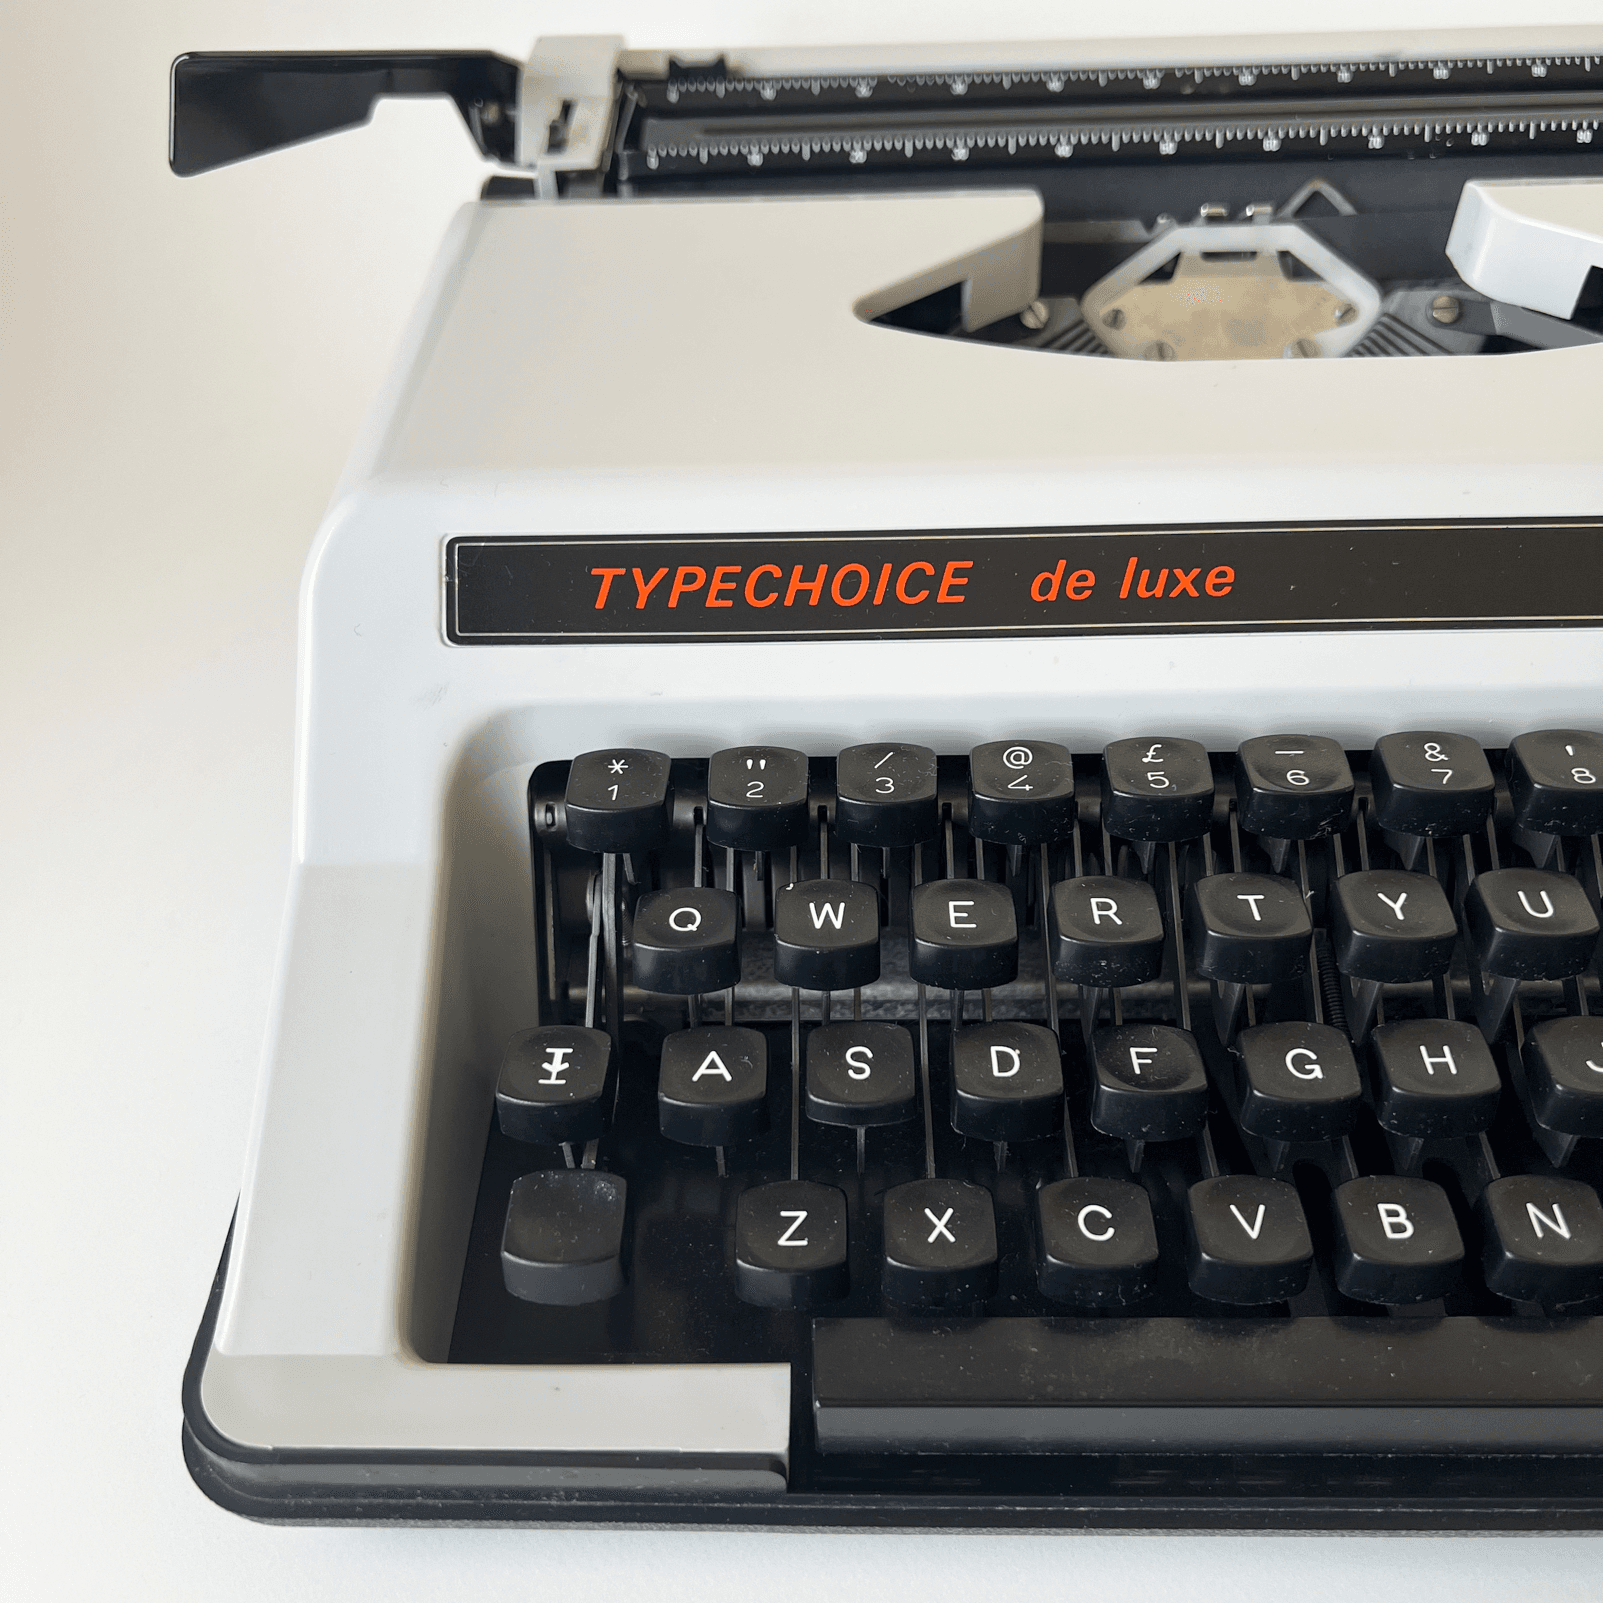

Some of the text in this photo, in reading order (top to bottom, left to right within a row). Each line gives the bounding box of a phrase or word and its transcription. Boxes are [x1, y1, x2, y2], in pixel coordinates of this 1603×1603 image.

[590, 556, 1235, 609] TYPECHOICE de luxe
[873, 751, 894, 769] /
[1002, 745, 1033, 770] @
[1141, 743, 1164, 763] £
[1423, 742, 1450, 762] &
[745, 780, 765, 798] 2
[875, 776, 895, 794] 3
[1007, 774, 1034, 792] 4
[1146, 771, 1170, 789] 5
[1286, 769, 1310, 786] 6
[1430, 768, 1453, 785] 7
[1570, 767, 1597, 784] 8
[607, 784, 619, 801] 1
[808, 901, 846, 930] W
[948, 900, 977, 929] E
[1089, 897, 1123, 926] R
[1236, 894, 1265, 922] T
[1377, 892, 1408, 921] Y
[1517, 890, 1555, 919] U
[668, 907, 702, 932] Q
[691, 1050, 733, 1082] A
[845, 1045, 874, 1081] S
[990, 1045, 1021, 1078] D
[1129, 1046, 1158, 1075] F
[1285, 1047, 1324, 1080] G
[1419, 1045, 1458, 1076] H
[777, 1210, 809, 1247] Z
[924, 1207, 956, 1244] X
[1077, 1204, 1115, 1242] C
[1229, 1204, 1266, 1240] V
[1377, 1203, 1415, 1240] B
[1525, 1202, 1572, 1240] N
